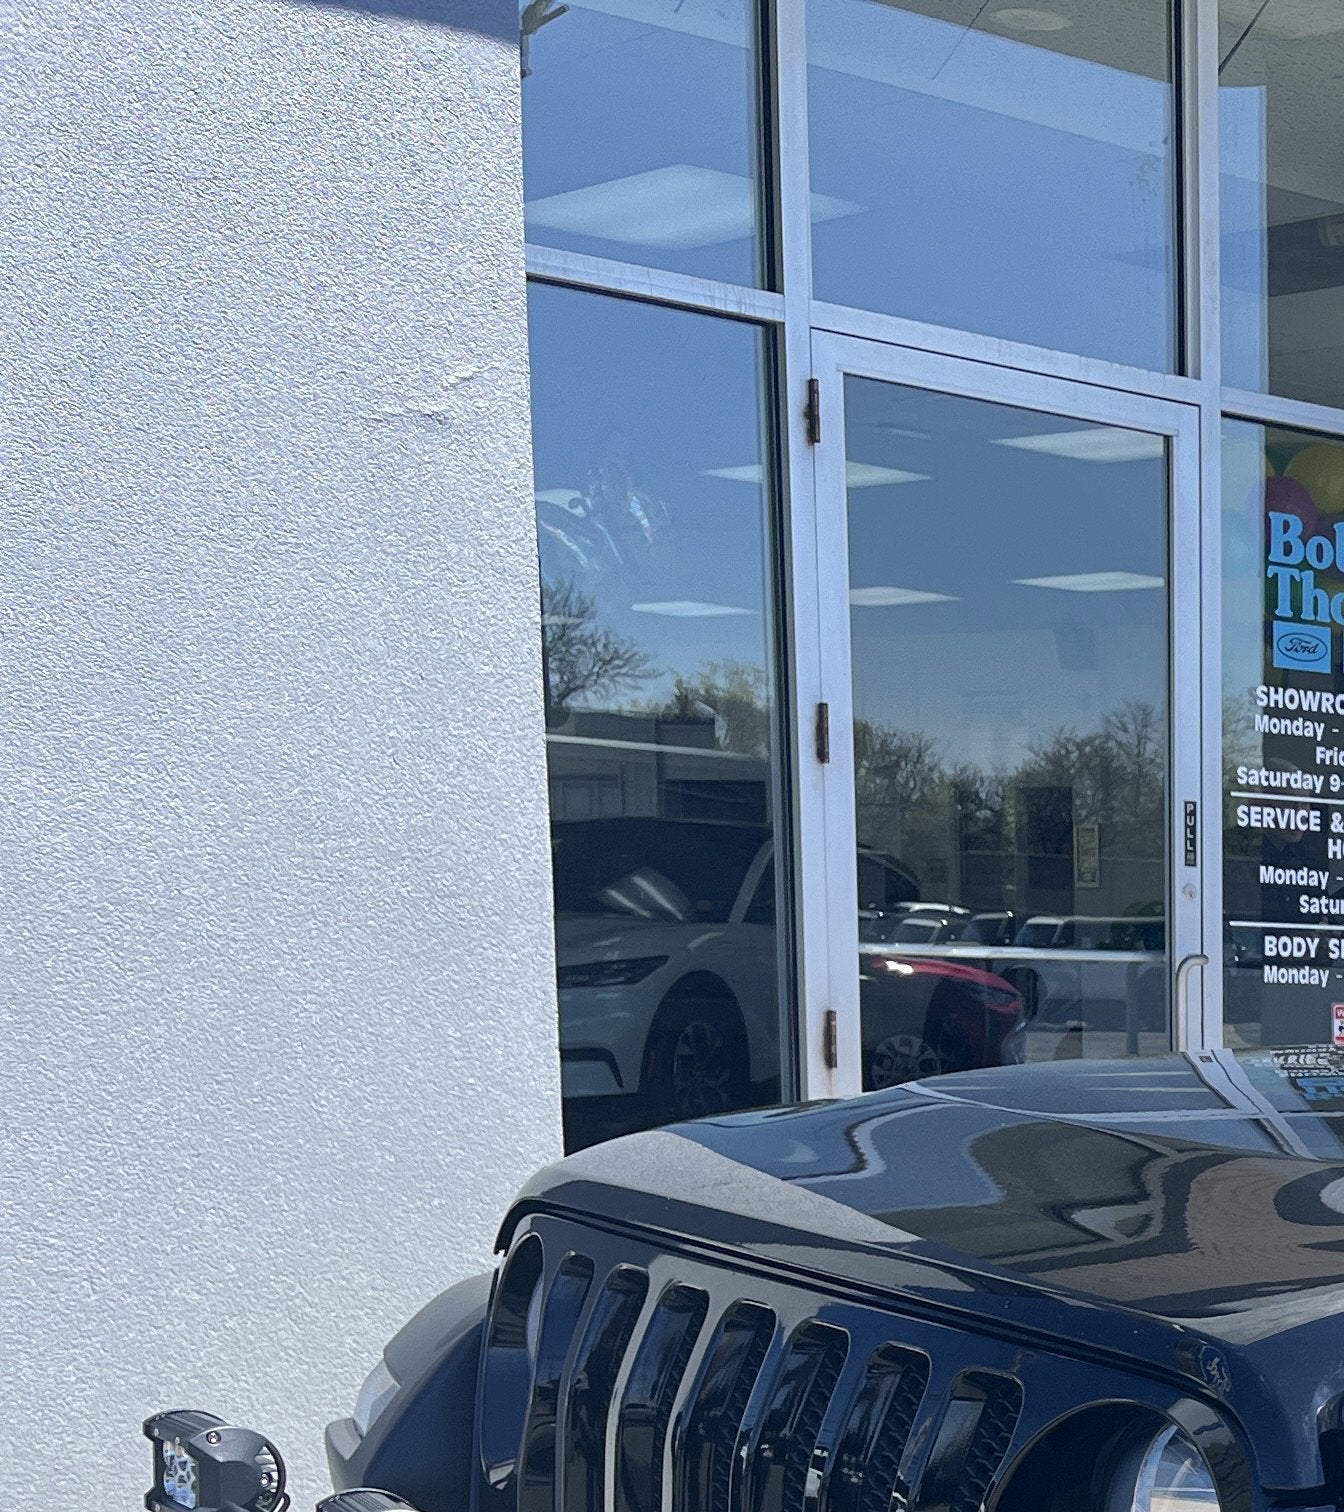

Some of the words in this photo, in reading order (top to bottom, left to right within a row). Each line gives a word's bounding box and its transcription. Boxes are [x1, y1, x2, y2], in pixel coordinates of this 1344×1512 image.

[1284, 637, 1320, 655] Ford
[1254, 715, 1326, 741] Monday
[1236, 766, 1324, 794] Saturday
[1186, 803, 1195, 851] PULL
[1236, 805, 1322, 832] SERVICE
[1259, 865, 1330, 891] Monday
[1264, 935, 1320, 959] BODY
[1264, 966, 1330, 989] Monday
